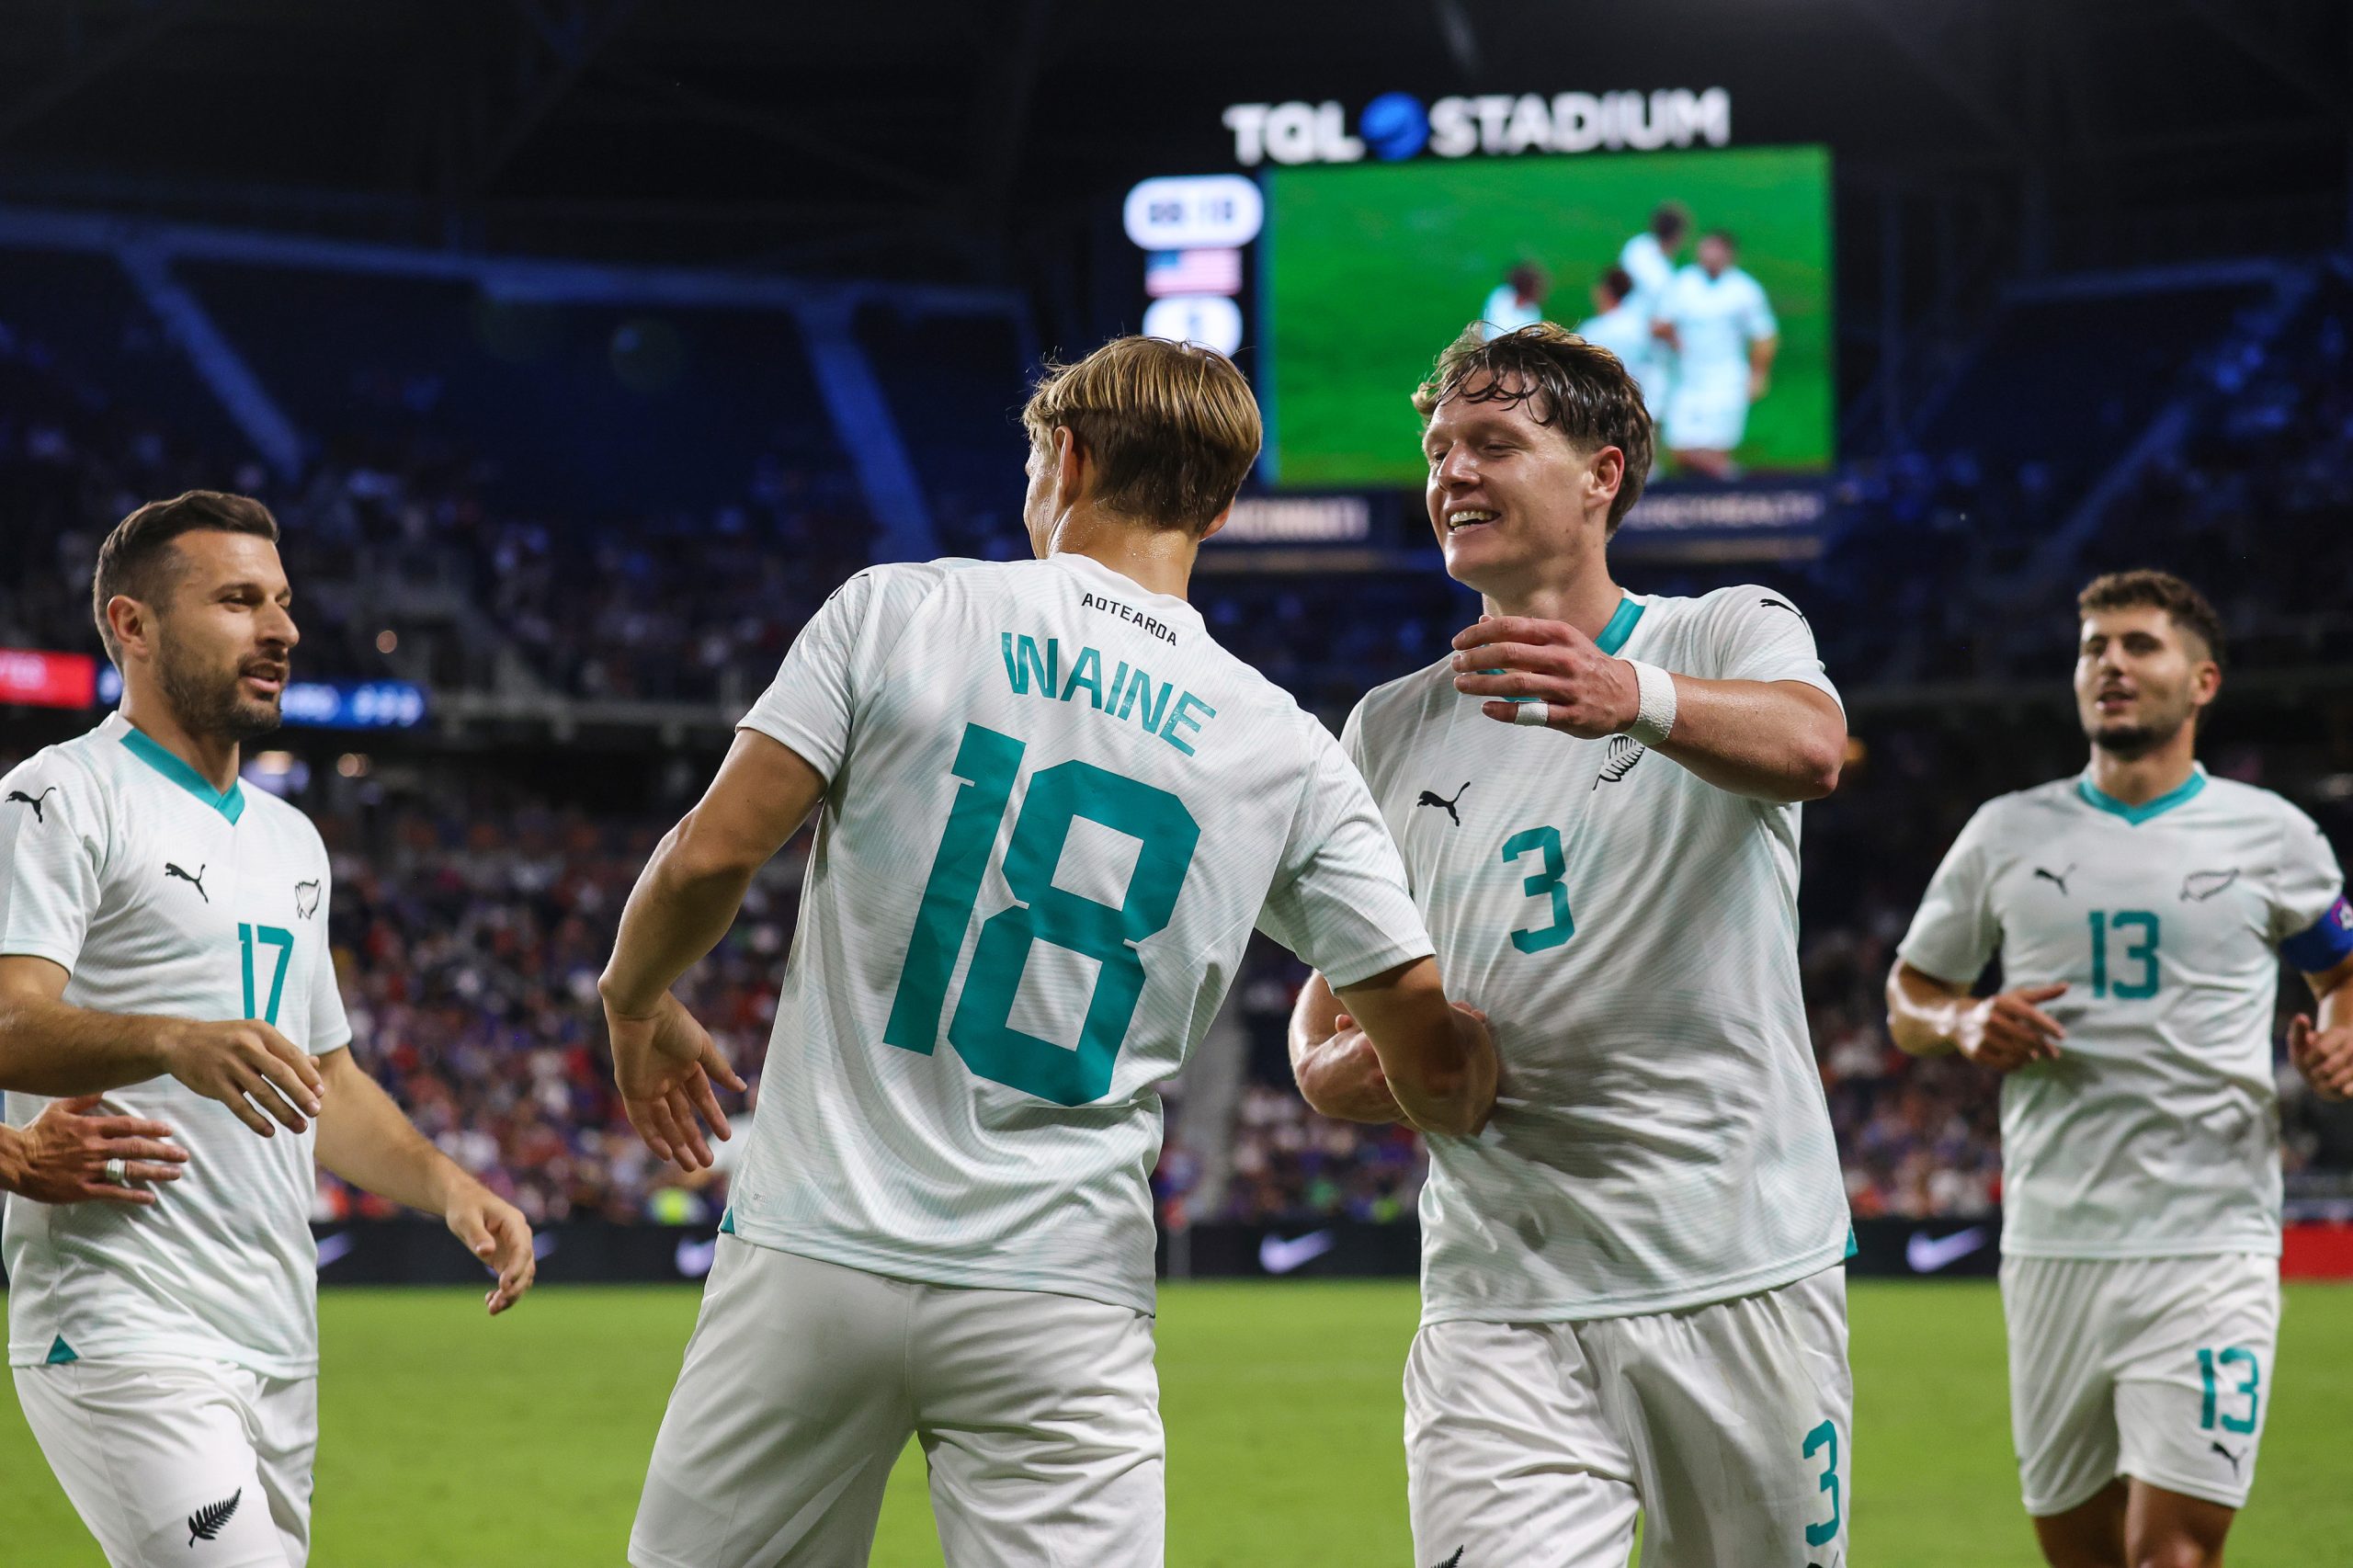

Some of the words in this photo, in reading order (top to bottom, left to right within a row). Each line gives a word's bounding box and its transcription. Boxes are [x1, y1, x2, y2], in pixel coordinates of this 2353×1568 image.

[1428, 86, 1731, 157] STADIUM
[1081, 592, 1176, 646] AOTEAROA
[1002, 631, 1217, 757] WAINE
[882, 722, 1201, 1108] 18
[1502, 825, 1574, 954] 3
[237, 922, 294, 1028] 17
[2087, 910, 2160, 999] 13
[2196, 1347, 2259, 1435] 13
[1802, 1419, 1839, 1547] 3
